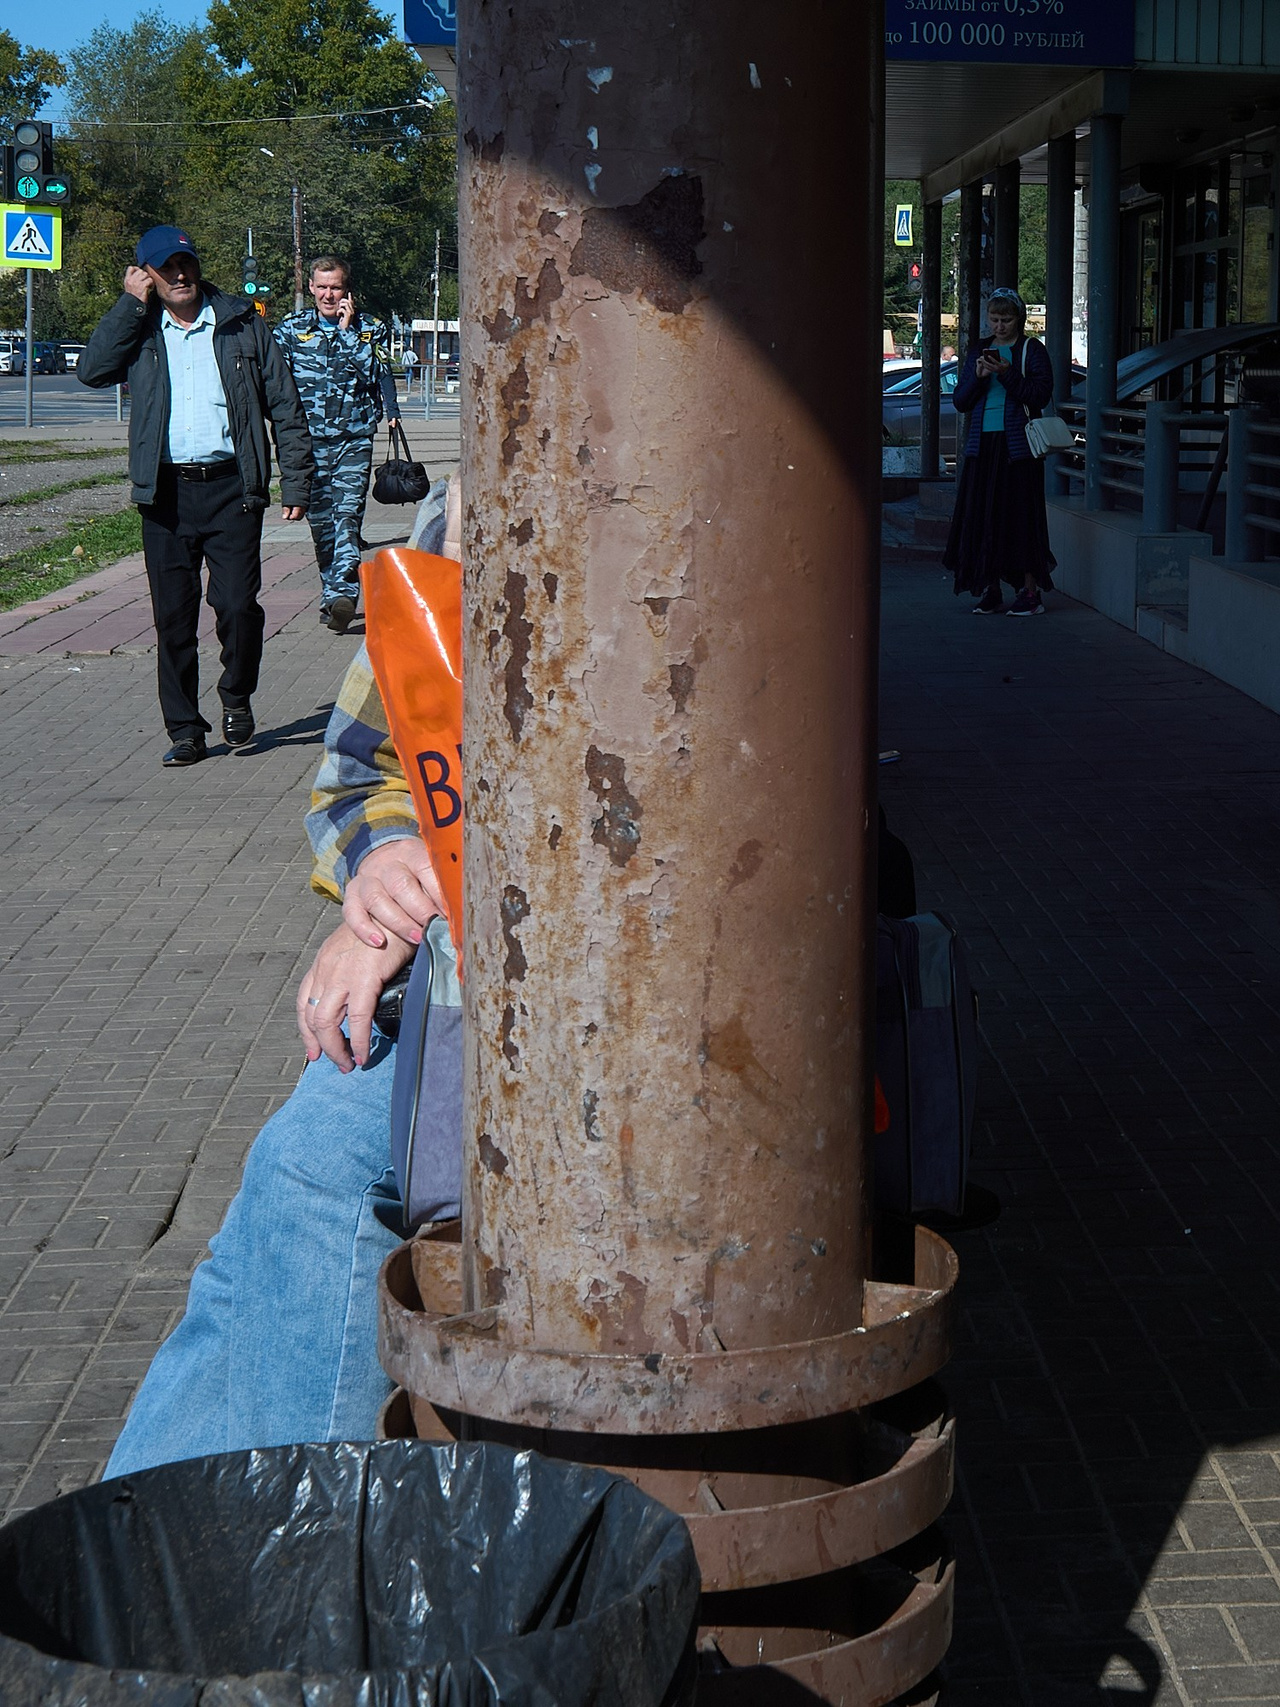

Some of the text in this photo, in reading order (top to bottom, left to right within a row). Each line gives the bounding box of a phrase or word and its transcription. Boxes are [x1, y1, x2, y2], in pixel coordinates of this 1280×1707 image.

[909, 21, 953, 45] 100
[960, 22, 1006, 46] 000
[1013, 30, 1086, 48] РУБЛЕЙ
